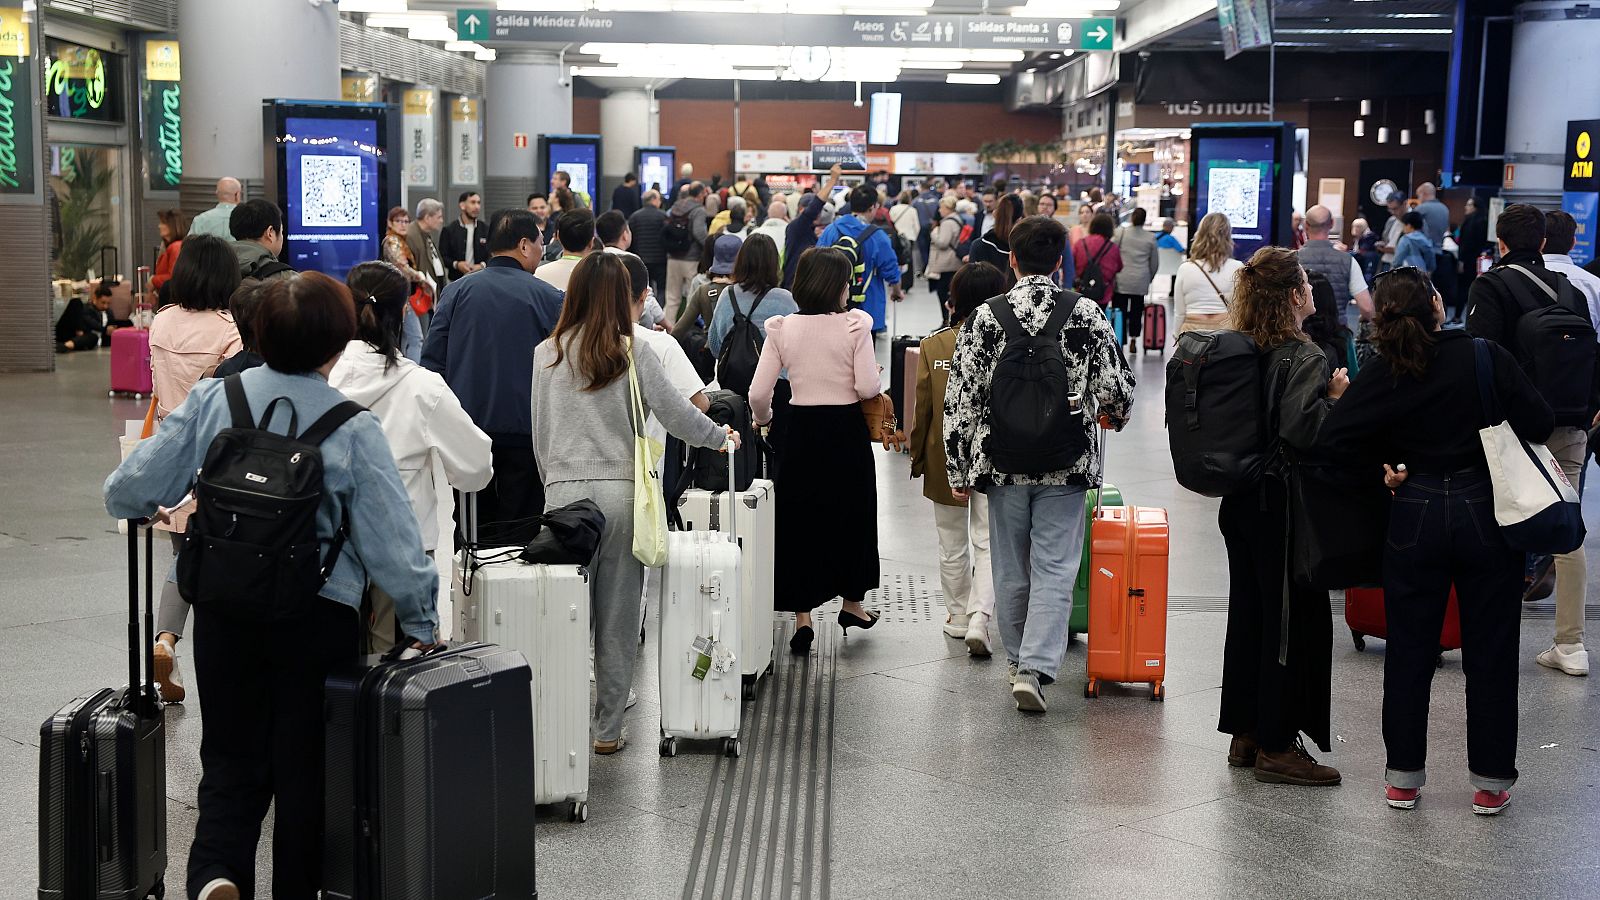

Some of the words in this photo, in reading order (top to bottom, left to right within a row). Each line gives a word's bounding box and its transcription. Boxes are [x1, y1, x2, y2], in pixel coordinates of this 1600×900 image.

[496, 15, 530, 28] Salida
[533, 14, 575, 28] Méndez
[578, 13, 613, 28] Álvaro
[853, 20, 885, 32] Aseos
[968, 21, 1005, 33] Salidas
[1006, 22, 1040, 34] Planta
[1041, 22, 1050, 34] 1
[159, 83, 183, 186] natura
[1571, 161, 1594, 178] ATM
